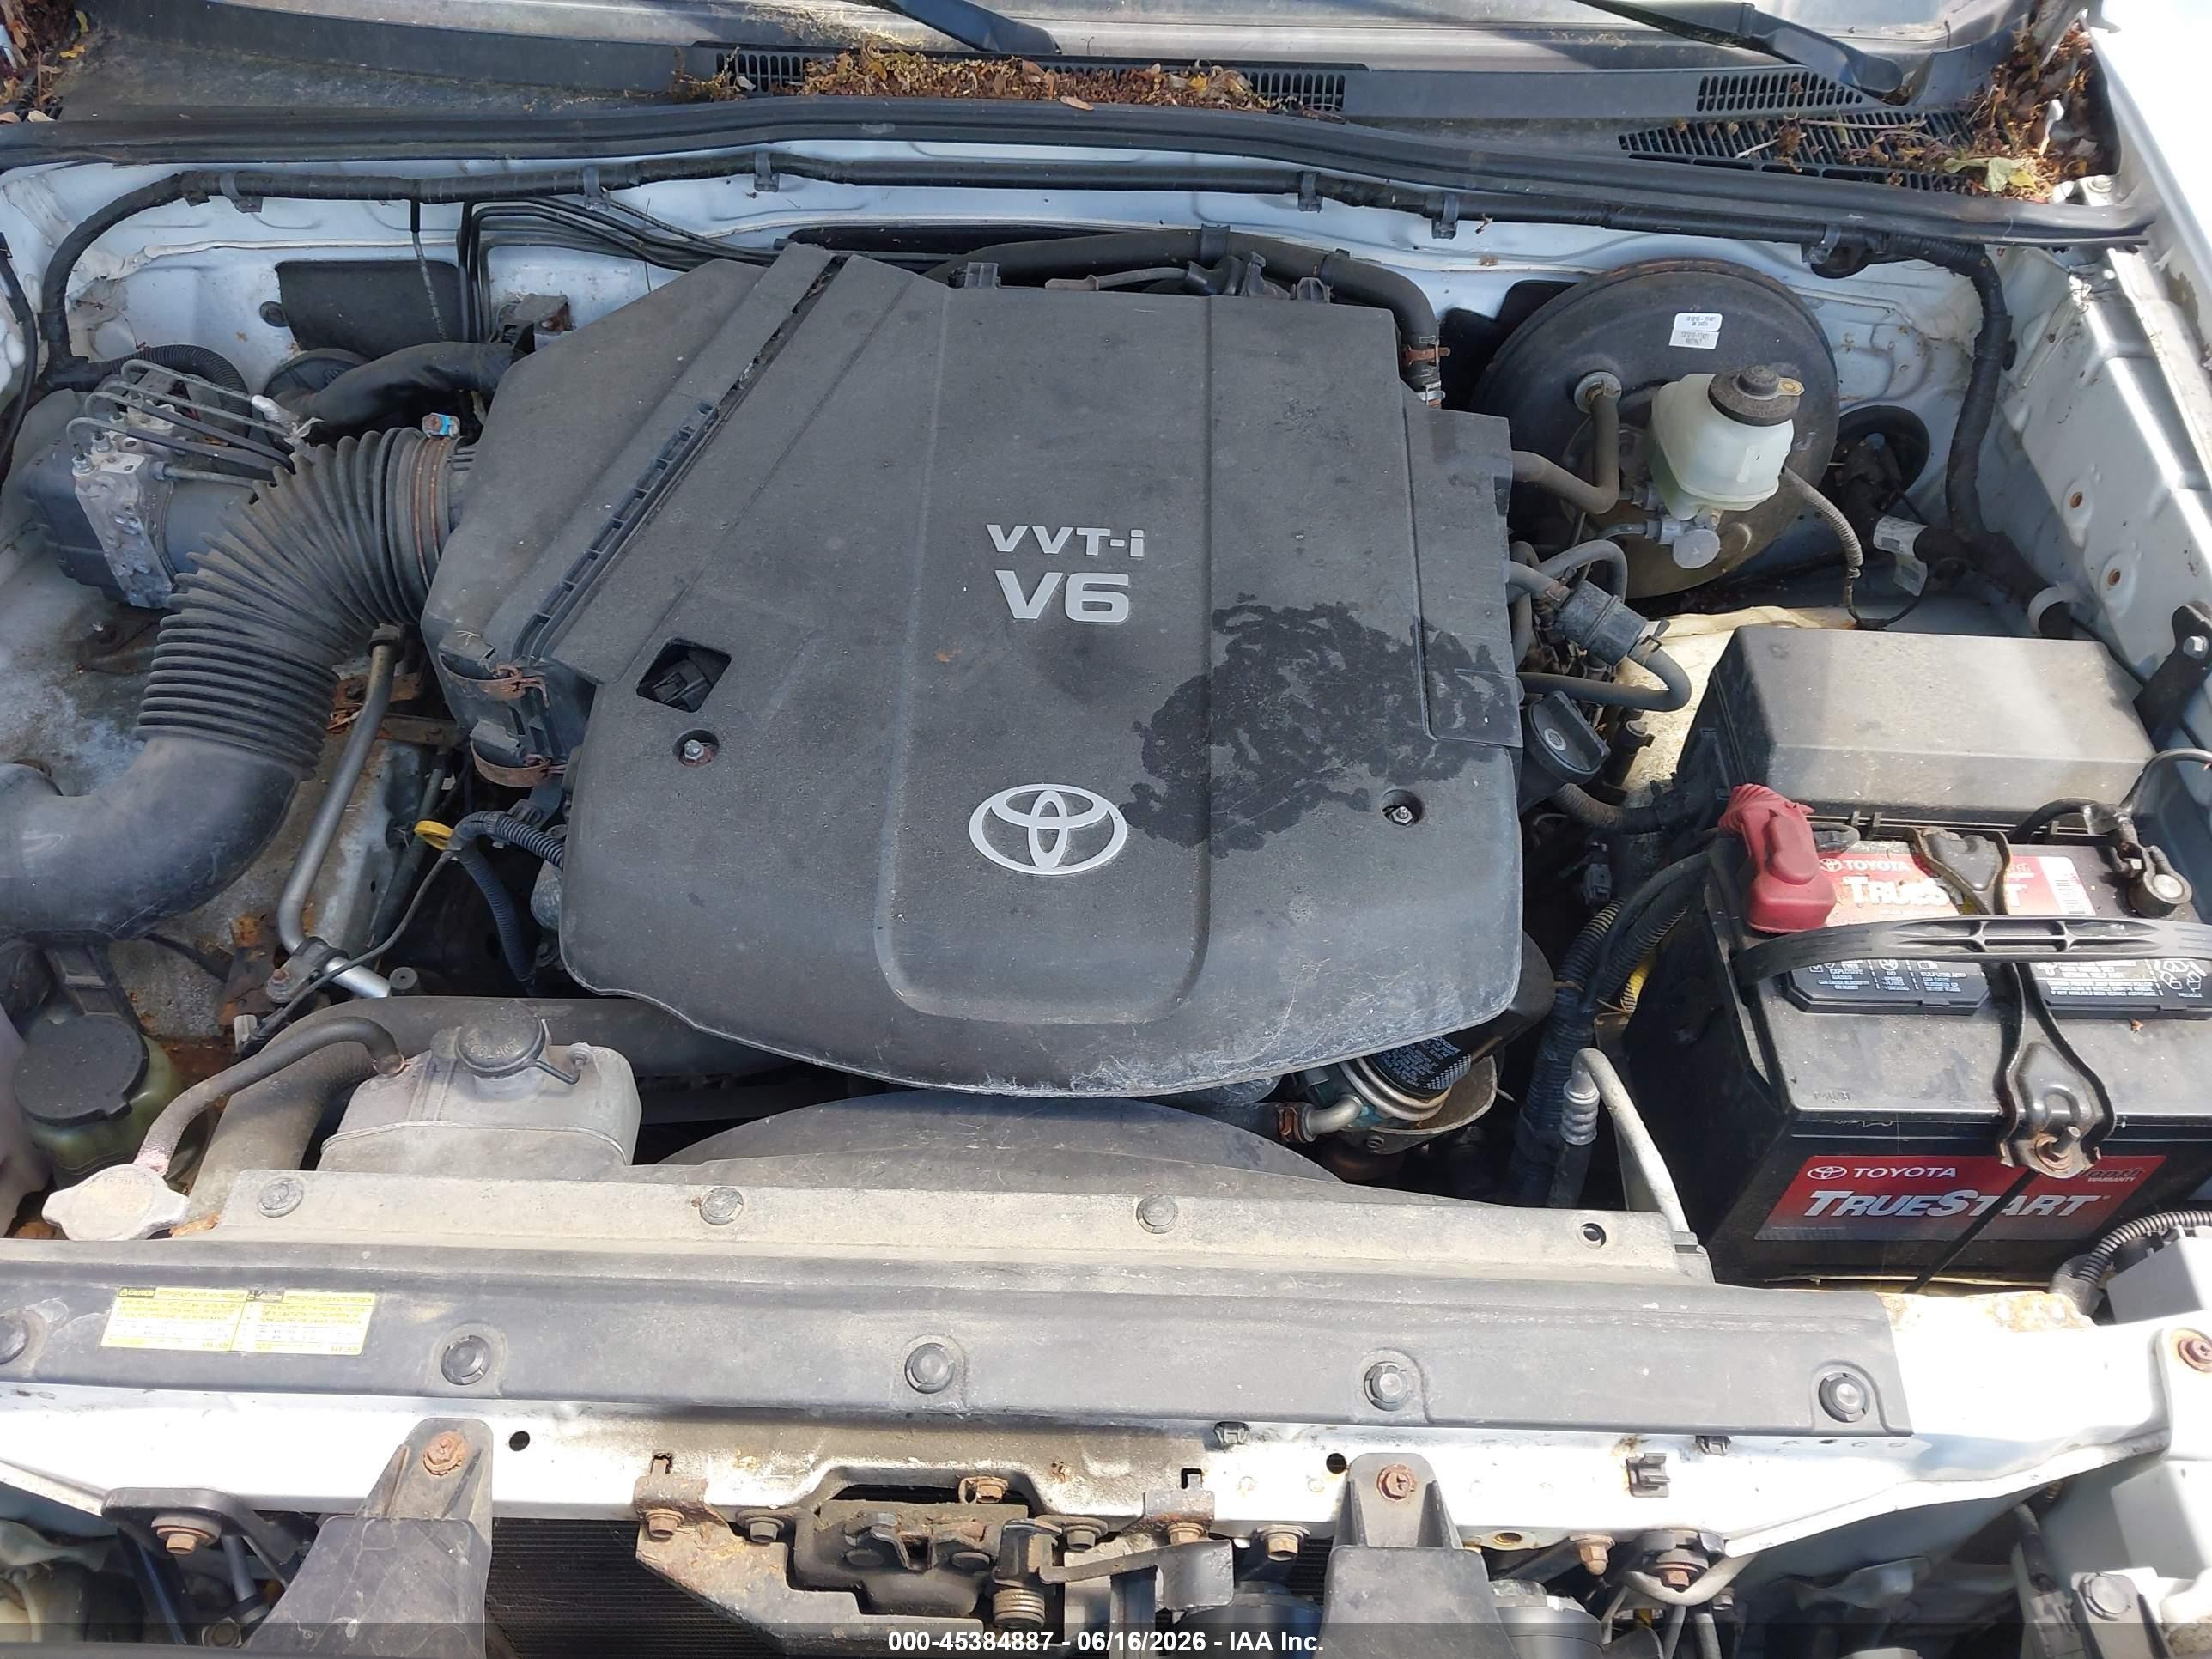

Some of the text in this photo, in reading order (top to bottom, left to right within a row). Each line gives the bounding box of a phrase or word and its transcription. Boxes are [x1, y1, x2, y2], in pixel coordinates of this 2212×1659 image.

[987, 524, 1144, 557] VVT-i
[995, 570, 1129, 623] V6
[1843, 860, 1911, 871] TOYOTA
[1853, 1167, 1957, 1179] TOYOTA
